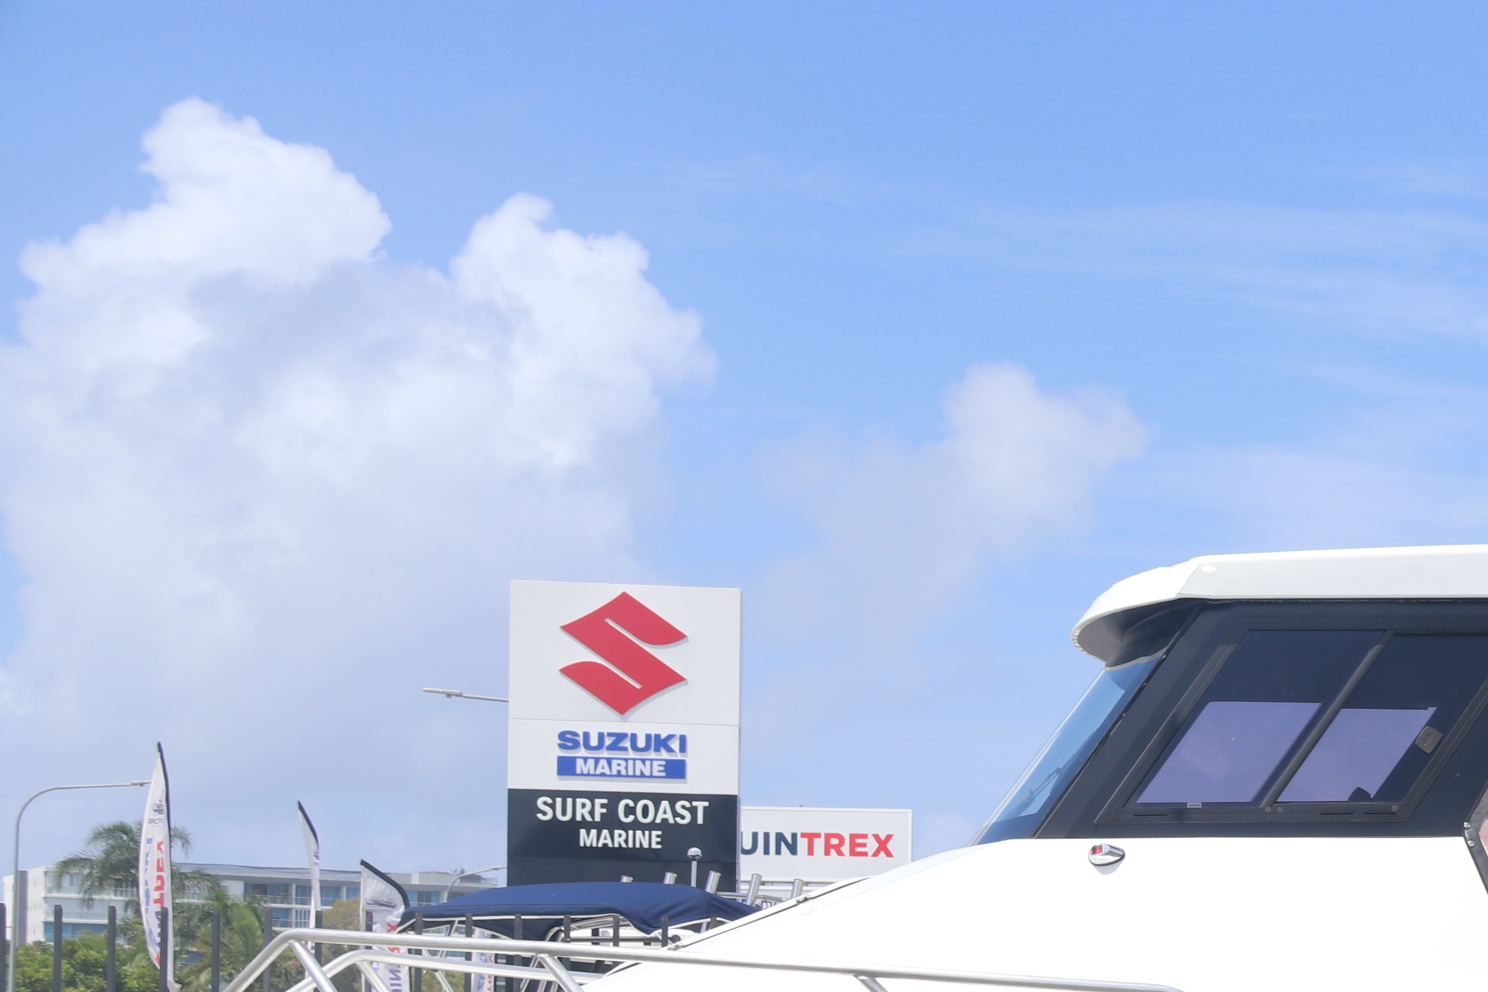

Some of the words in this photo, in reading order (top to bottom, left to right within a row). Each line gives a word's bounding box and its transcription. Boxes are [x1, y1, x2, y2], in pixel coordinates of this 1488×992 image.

[557, 730, 687, 753] SUZUKI
[576, 758, 667, 777] MARINE
[536, 796, 608, 822] SURF
[618, 799, 709, 824] COAST
[579, 828, 662, 849] MARINE
[740, 831, 895, 858] UINTREX
